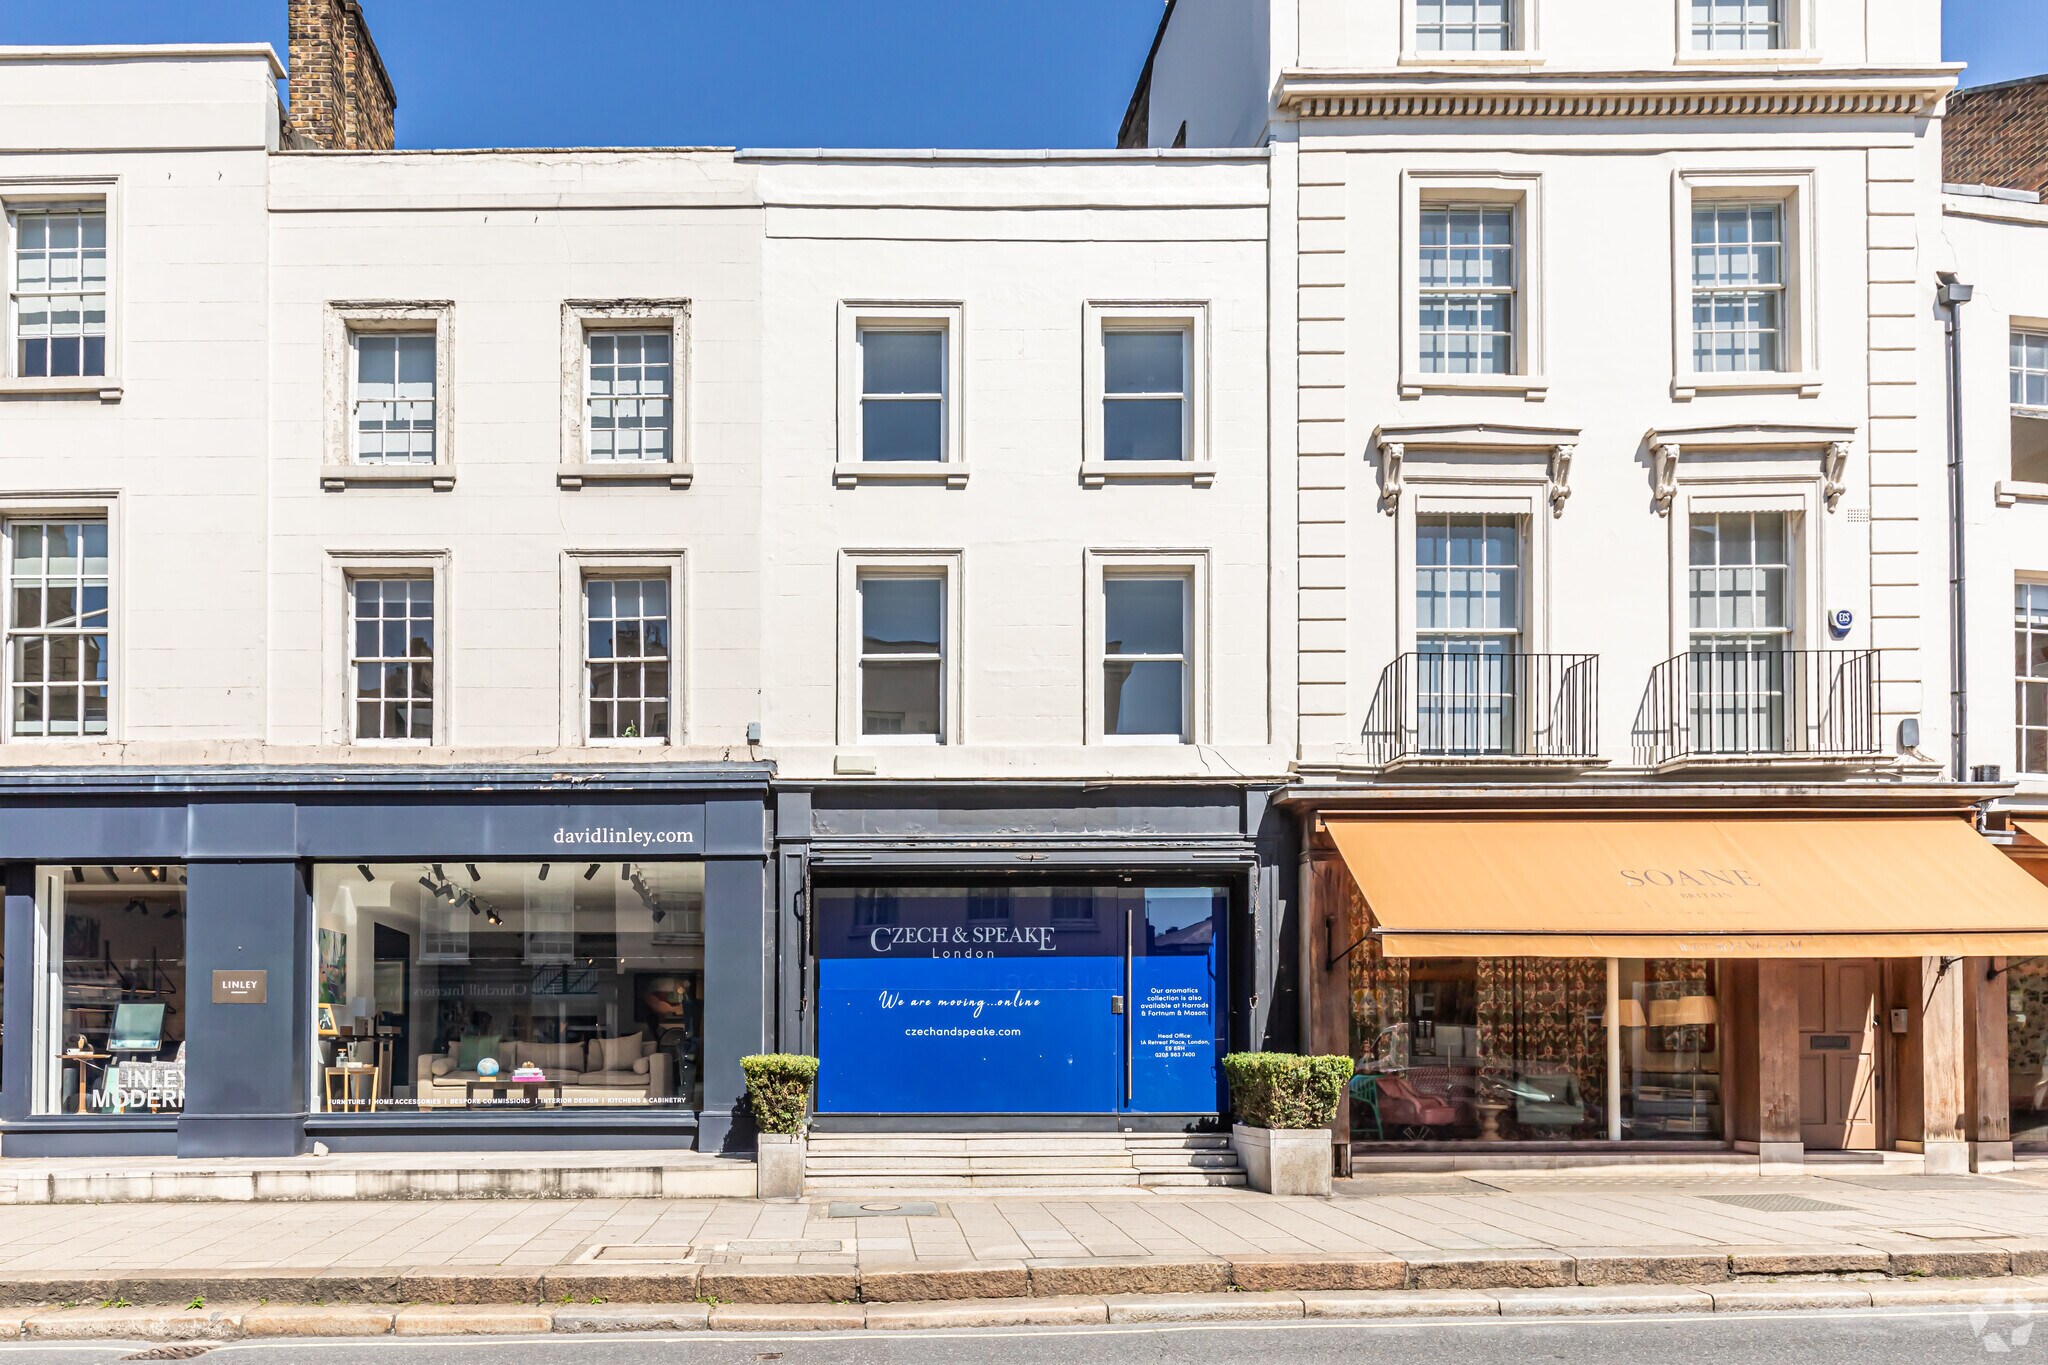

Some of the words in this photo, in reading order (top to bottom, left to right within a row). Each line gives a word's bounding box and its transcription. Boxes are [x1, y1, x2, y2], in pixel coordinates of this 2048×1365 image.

[553, 827, 694, 847] davidlinley.com
[1620, 869, 1761, 887] SOANE
[870, 927, 948, 952] CZECH
[952, 926, 969, 943] &
[973, 927, 1057, 951] SPEAKE
[932, 948, 994, 959] London
[222, 980, 257, 989] LINLEY
[878, 990, 905, 1009] We
[910, 999, 932, 1007] are
[905, 1027, 1021, 1038] czechandspeake.com
